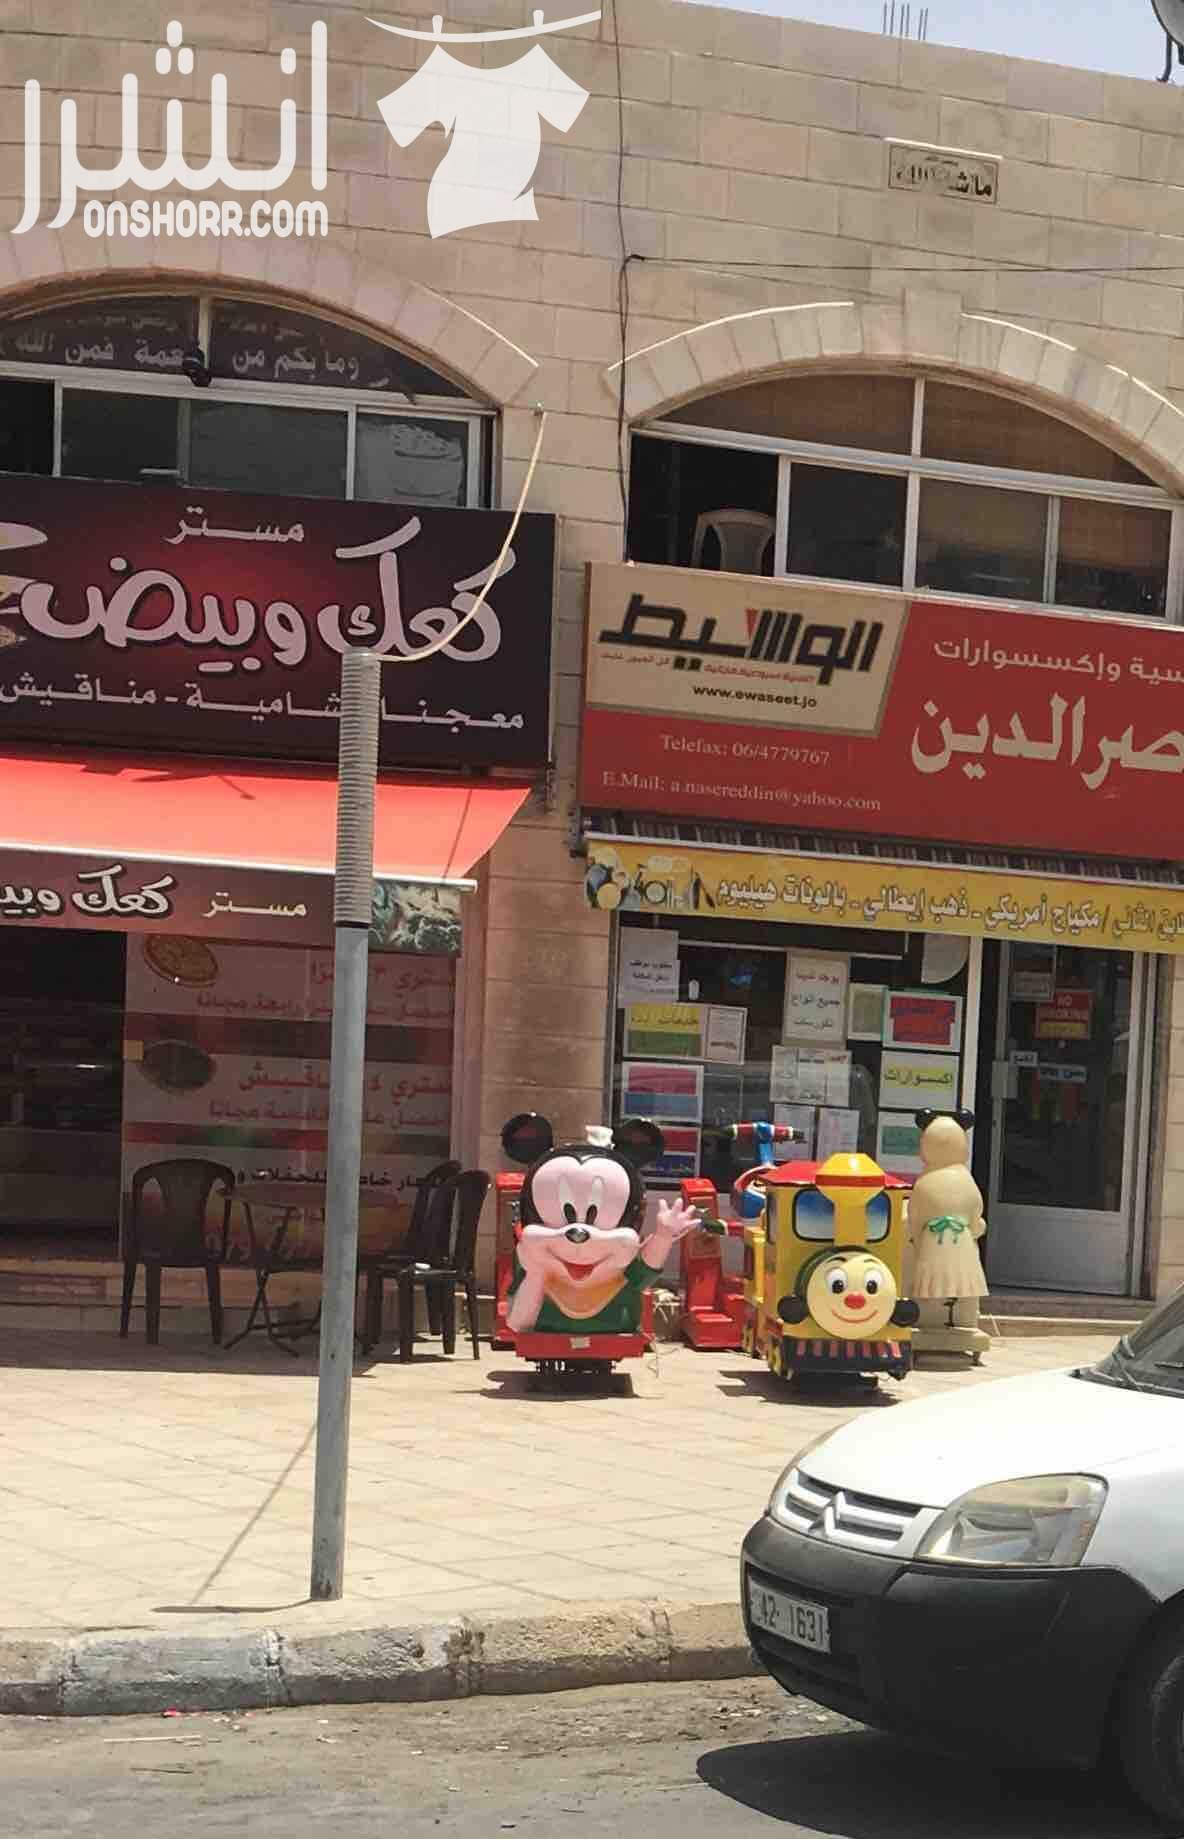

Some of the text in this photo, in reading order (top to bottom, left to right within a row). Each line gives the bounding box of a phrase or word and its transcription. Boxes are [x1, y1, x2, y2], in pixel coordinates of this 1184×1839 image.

[134, 338, 201, 366] عمة
[231, 345, 265, 373] من
[164, 505, 305, 545] مستر
[693, 684, 817, 709] www.ewaseet.jo
[380, 697, 524, 734] معجنا
[660, 733, 727, 756] Telefax:
[910, 691, 1087, 780] الدين
[602, 770, 665, 793] E.Mail:
[0, 863, 307, 919] مستر كعك وبي
